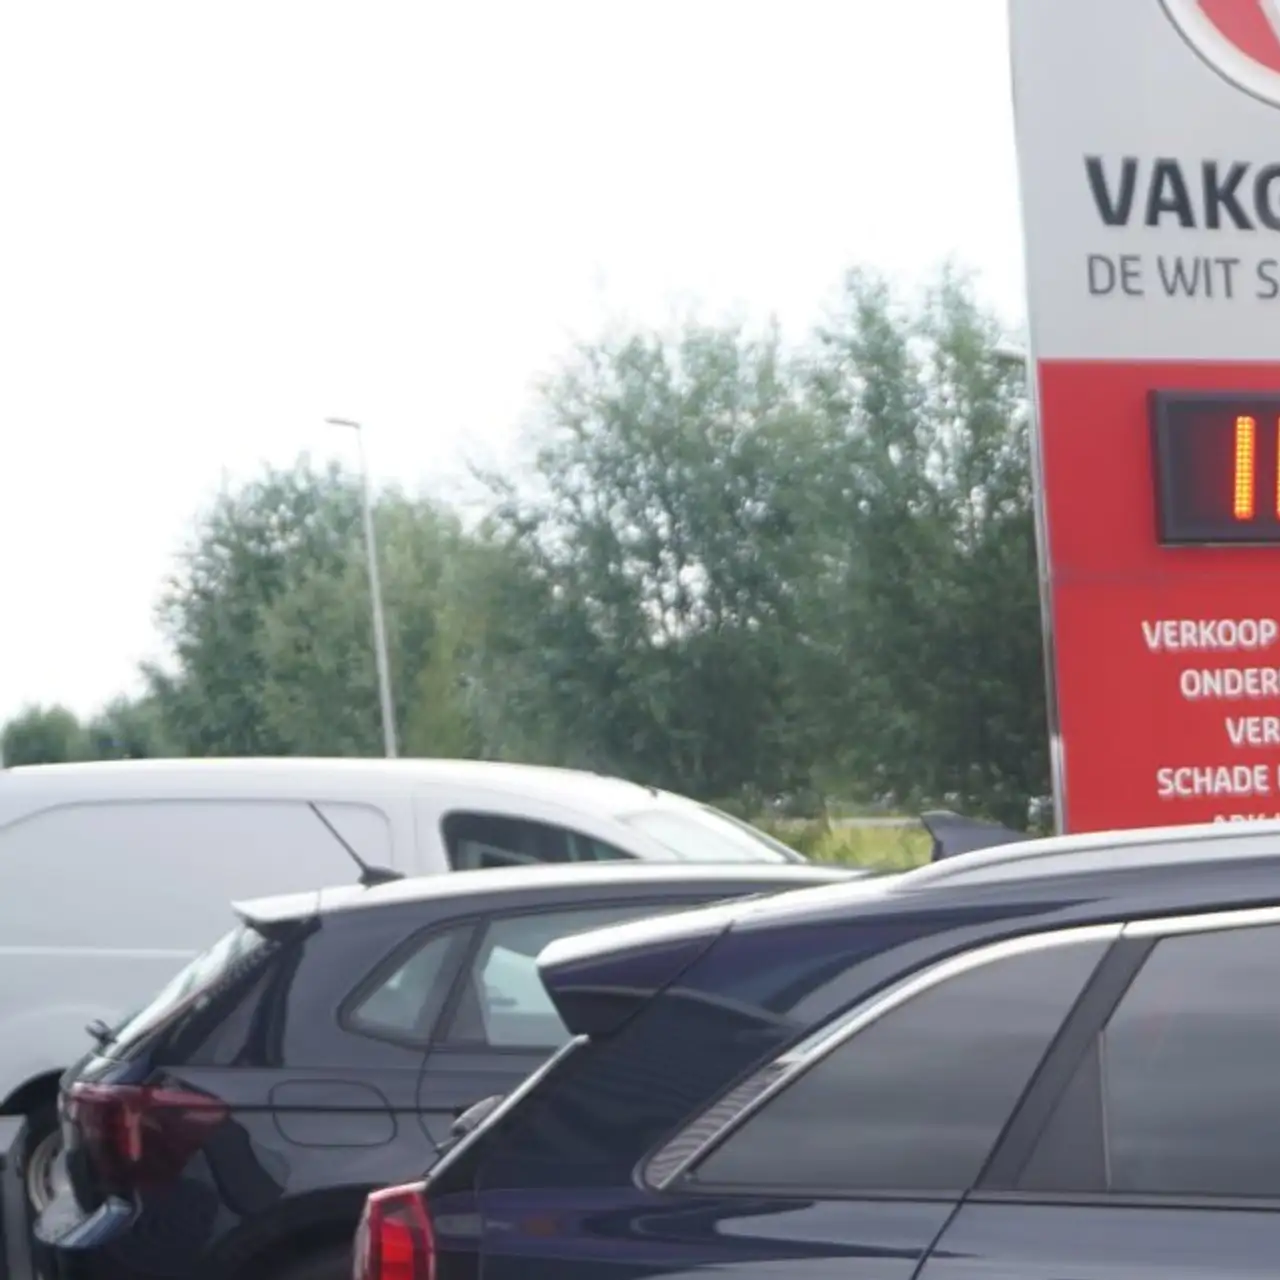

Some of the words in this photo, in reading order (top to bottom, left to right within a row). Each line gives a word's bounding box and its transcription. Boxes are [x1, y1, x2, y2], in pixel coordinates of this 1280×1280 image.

[1086, 255, 1144, 296] DE
[1157, 257, 1240, 299] WIT
[1141, 618, 1278, 649] VERKOOP
[1156, 765, 1269, 797] SCHADE
